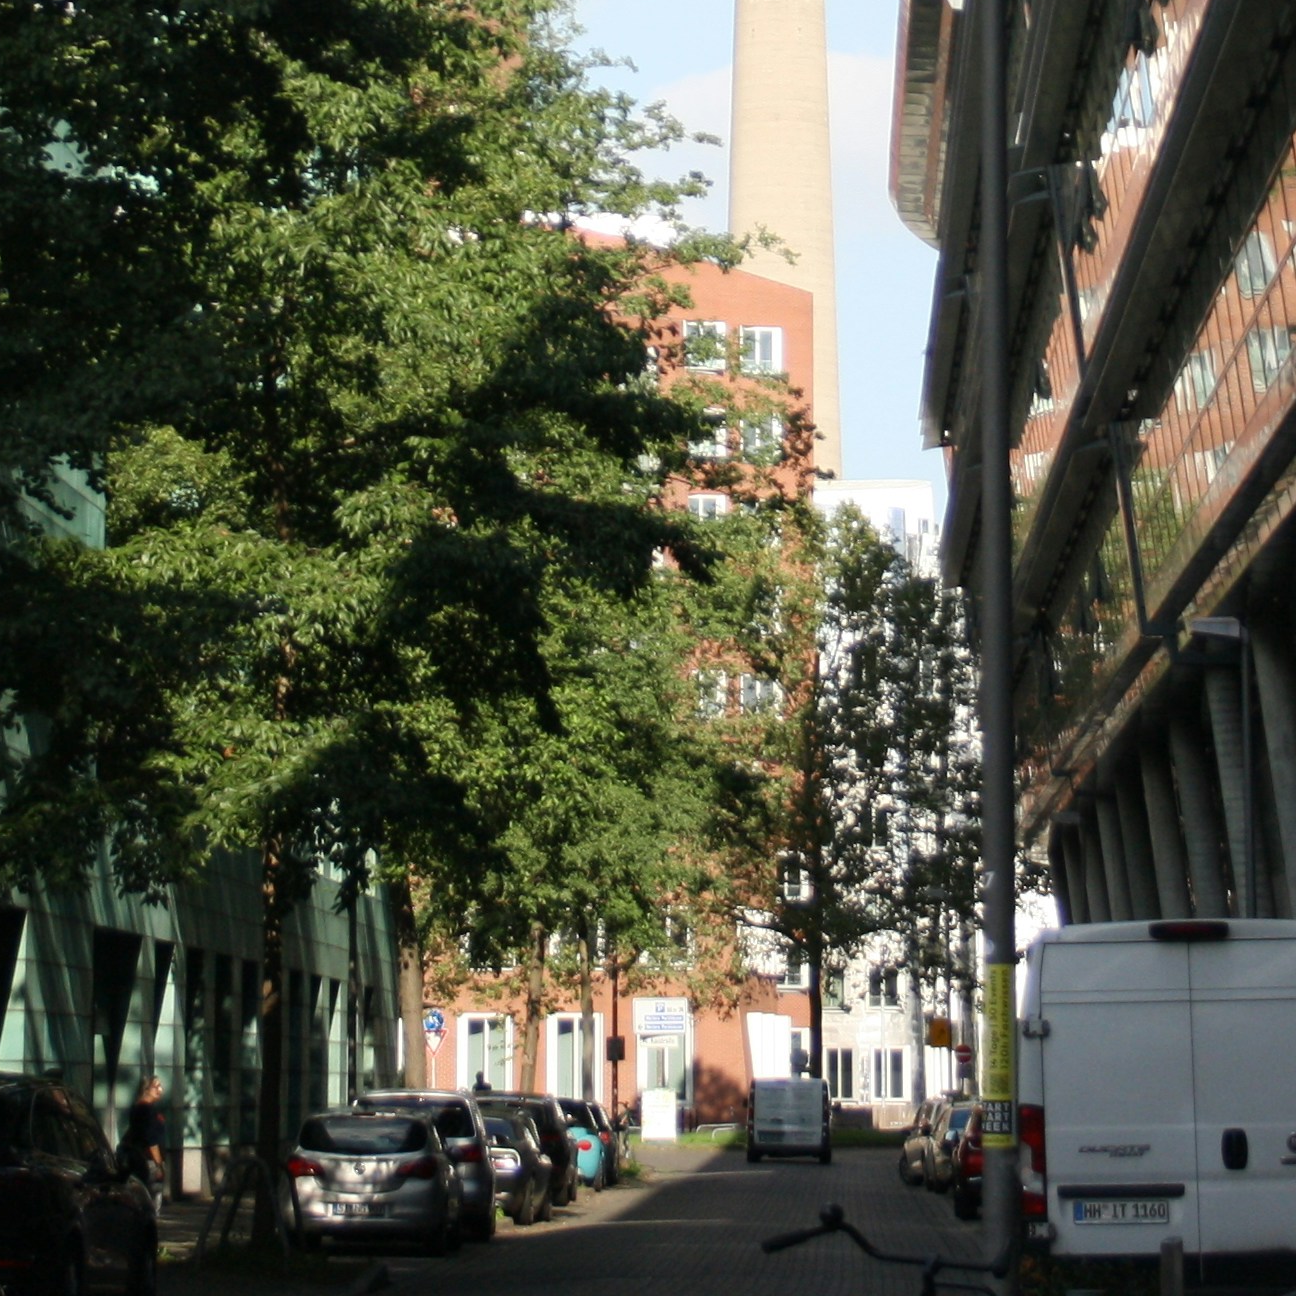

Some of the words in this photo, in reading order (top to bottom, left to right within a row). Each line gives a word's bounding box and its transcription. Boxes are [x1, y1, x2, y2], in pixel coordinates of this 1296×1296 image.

[1084, 1203, 1101, 1218] HH
[1112, 1203, 1127, 1218] IT
[1132, 1203, 1166, 1218] 1160
